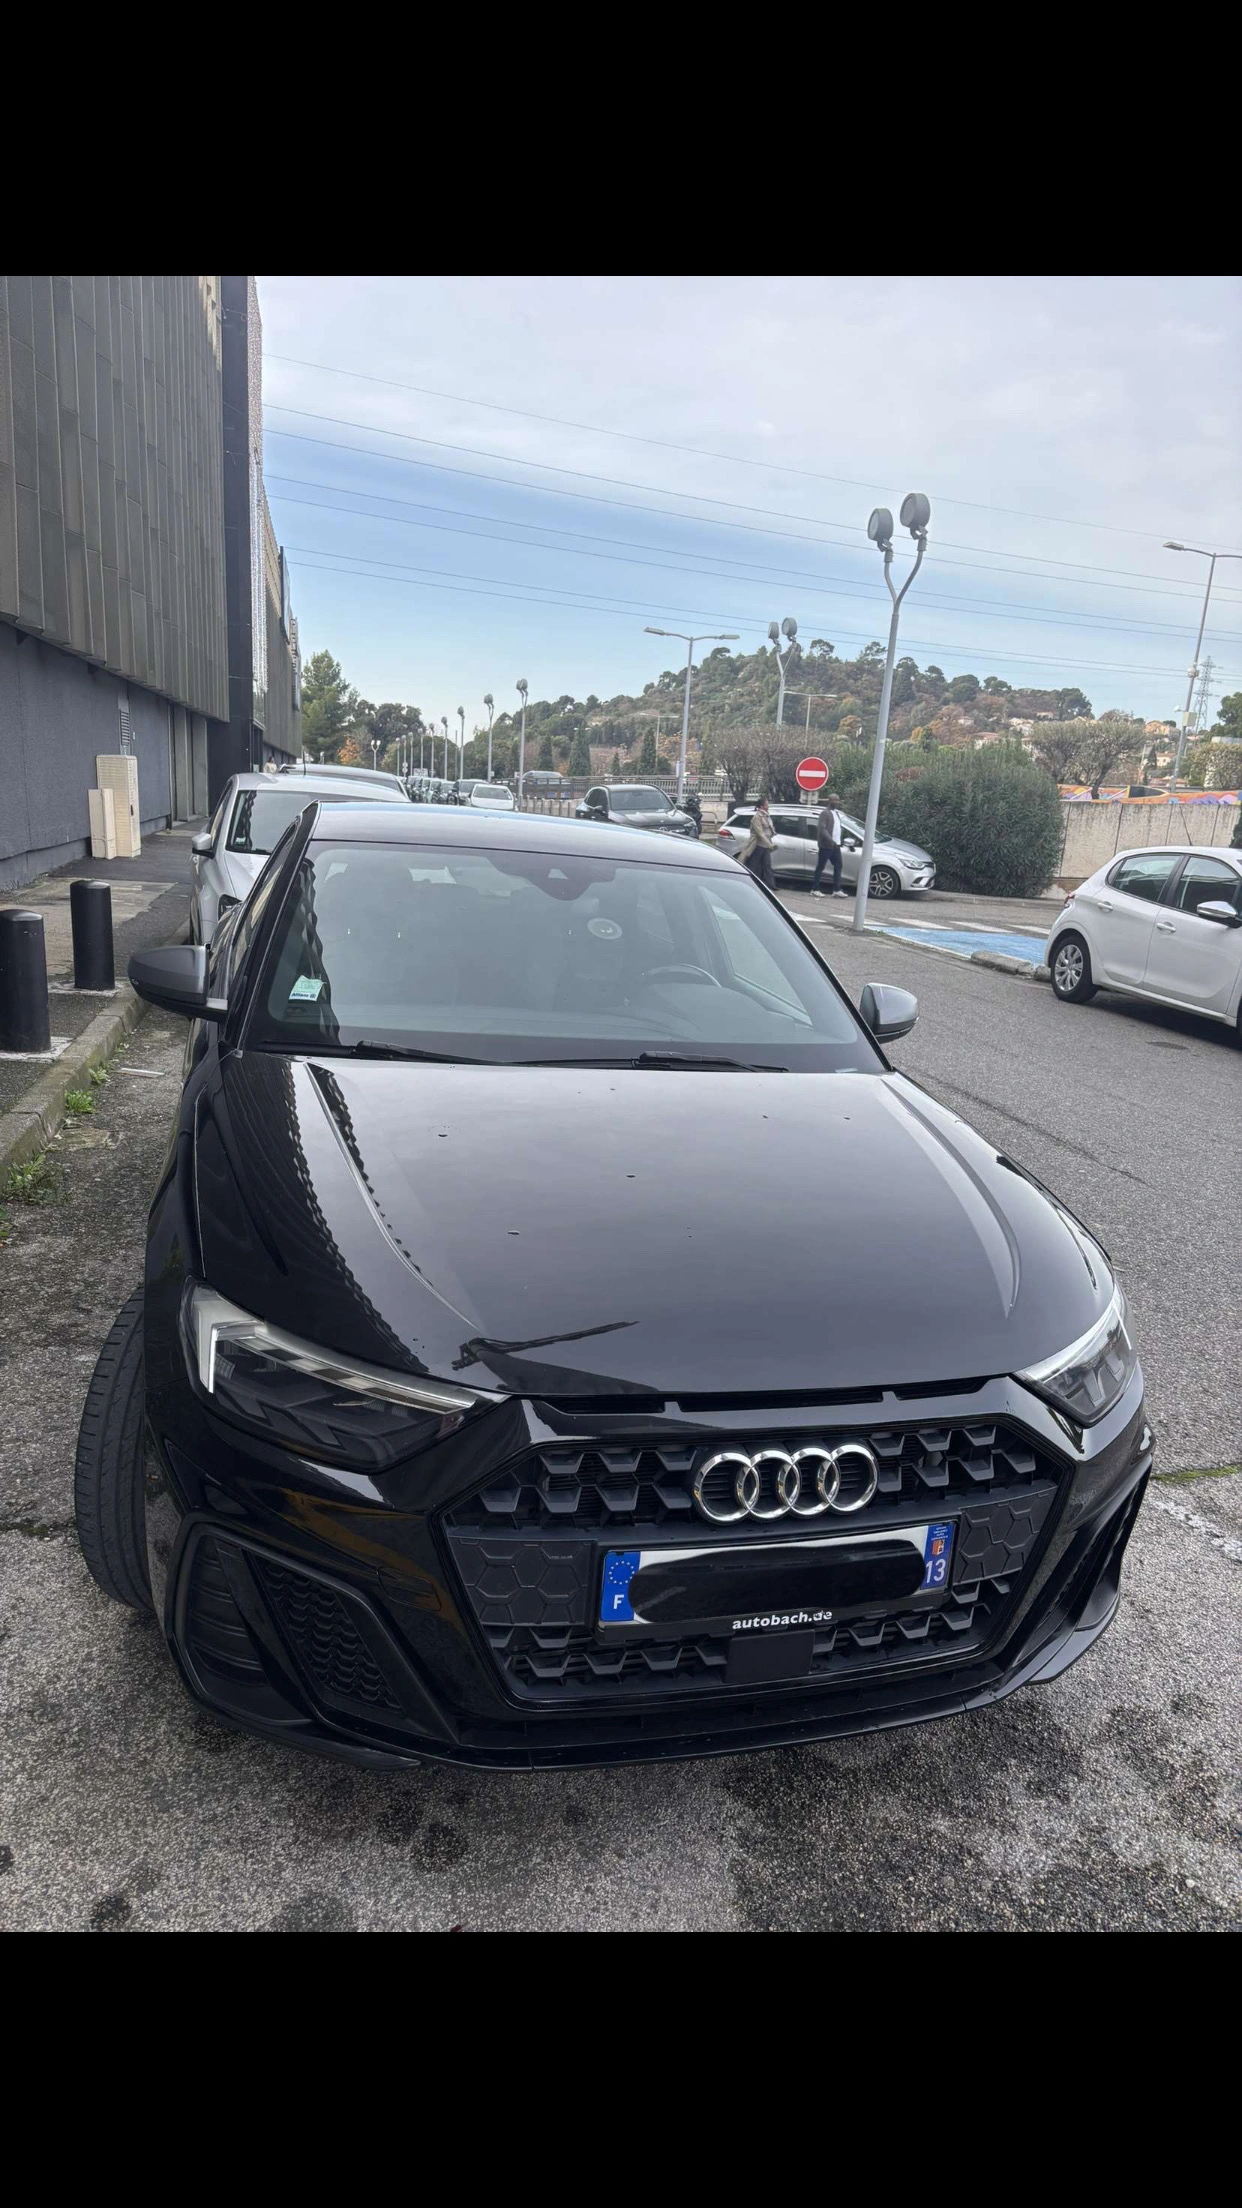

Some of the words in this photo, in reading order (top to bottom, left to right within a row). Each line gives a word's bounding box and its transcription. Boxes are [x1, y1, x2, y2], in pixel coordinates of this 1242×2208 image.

[925, 1558, 947, 1584] 13
[613, 1594, 625, 1610] F
[732, 1609, 833, 1630] autobach.de
